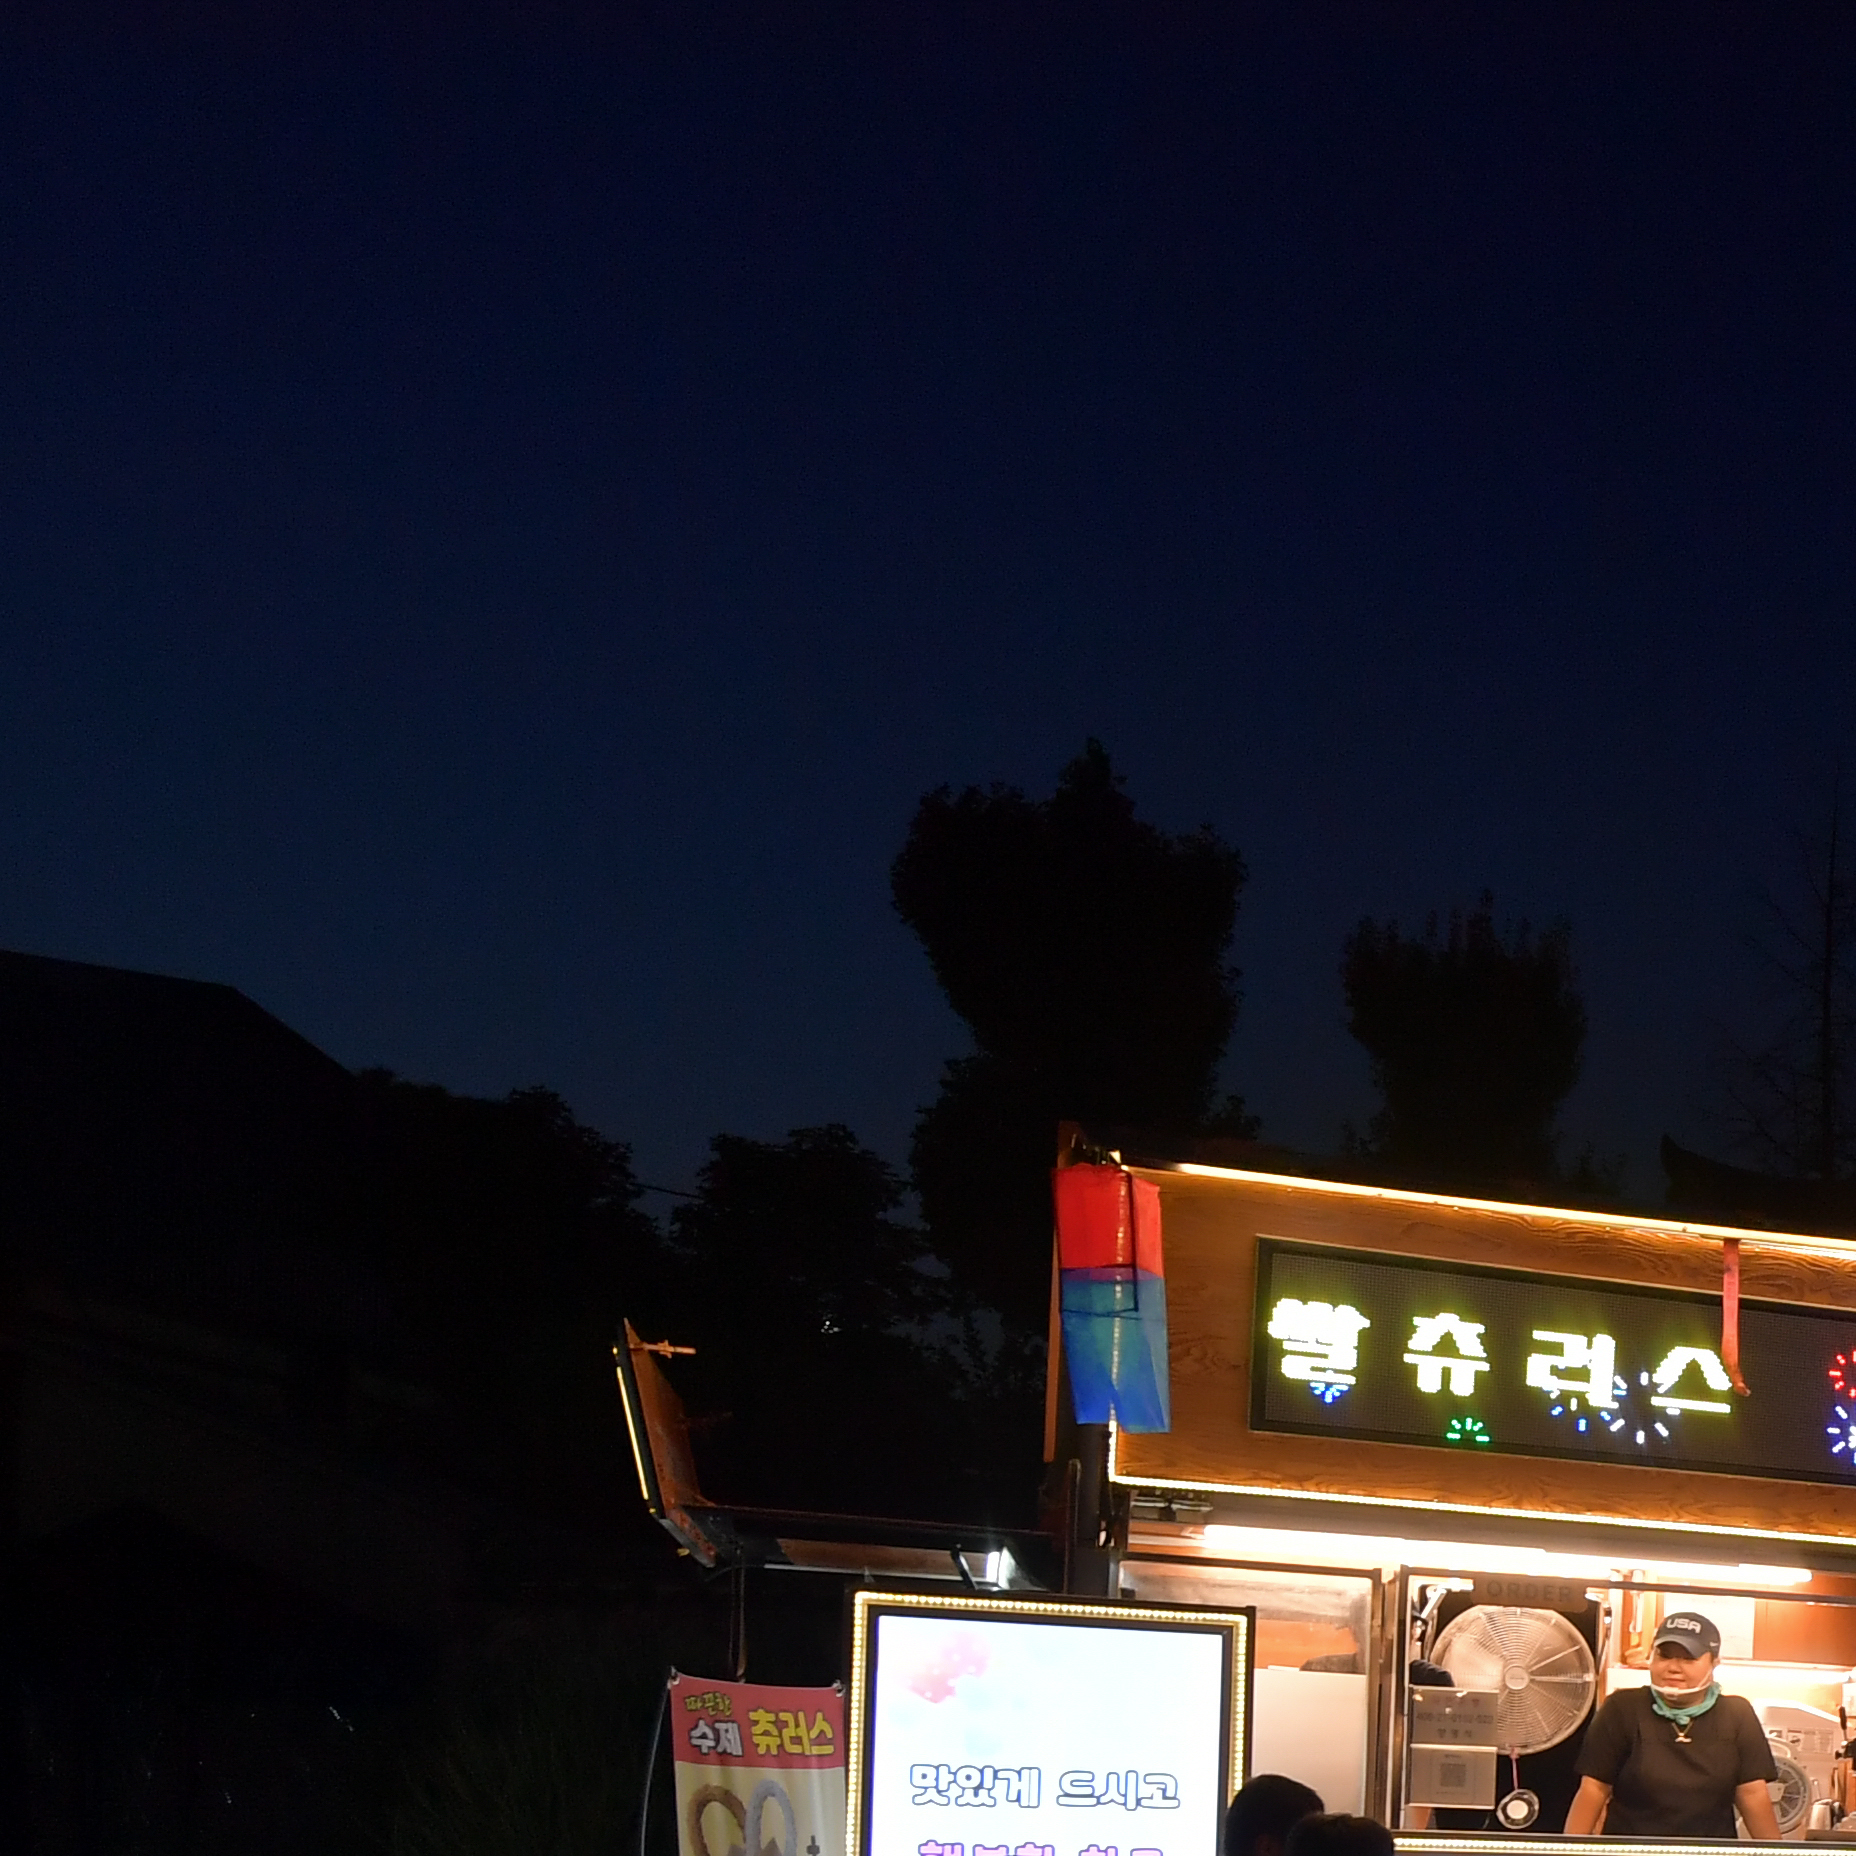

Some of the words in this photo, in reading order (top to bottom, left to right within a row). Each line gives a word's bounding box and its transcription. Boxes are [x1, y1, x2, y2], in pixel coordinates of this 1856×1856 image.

[1485, 1579, 1571, 1602] ORDER
[1666, 1617, 1702, 1634] USA
[689, 1718, 744, 1757] 수제
[748, 1707, 836, 1757] 츄러스
[910, 1764, 1042, 1809] 맛있게
[1056, 1769, 1181, 1812] 드시고
